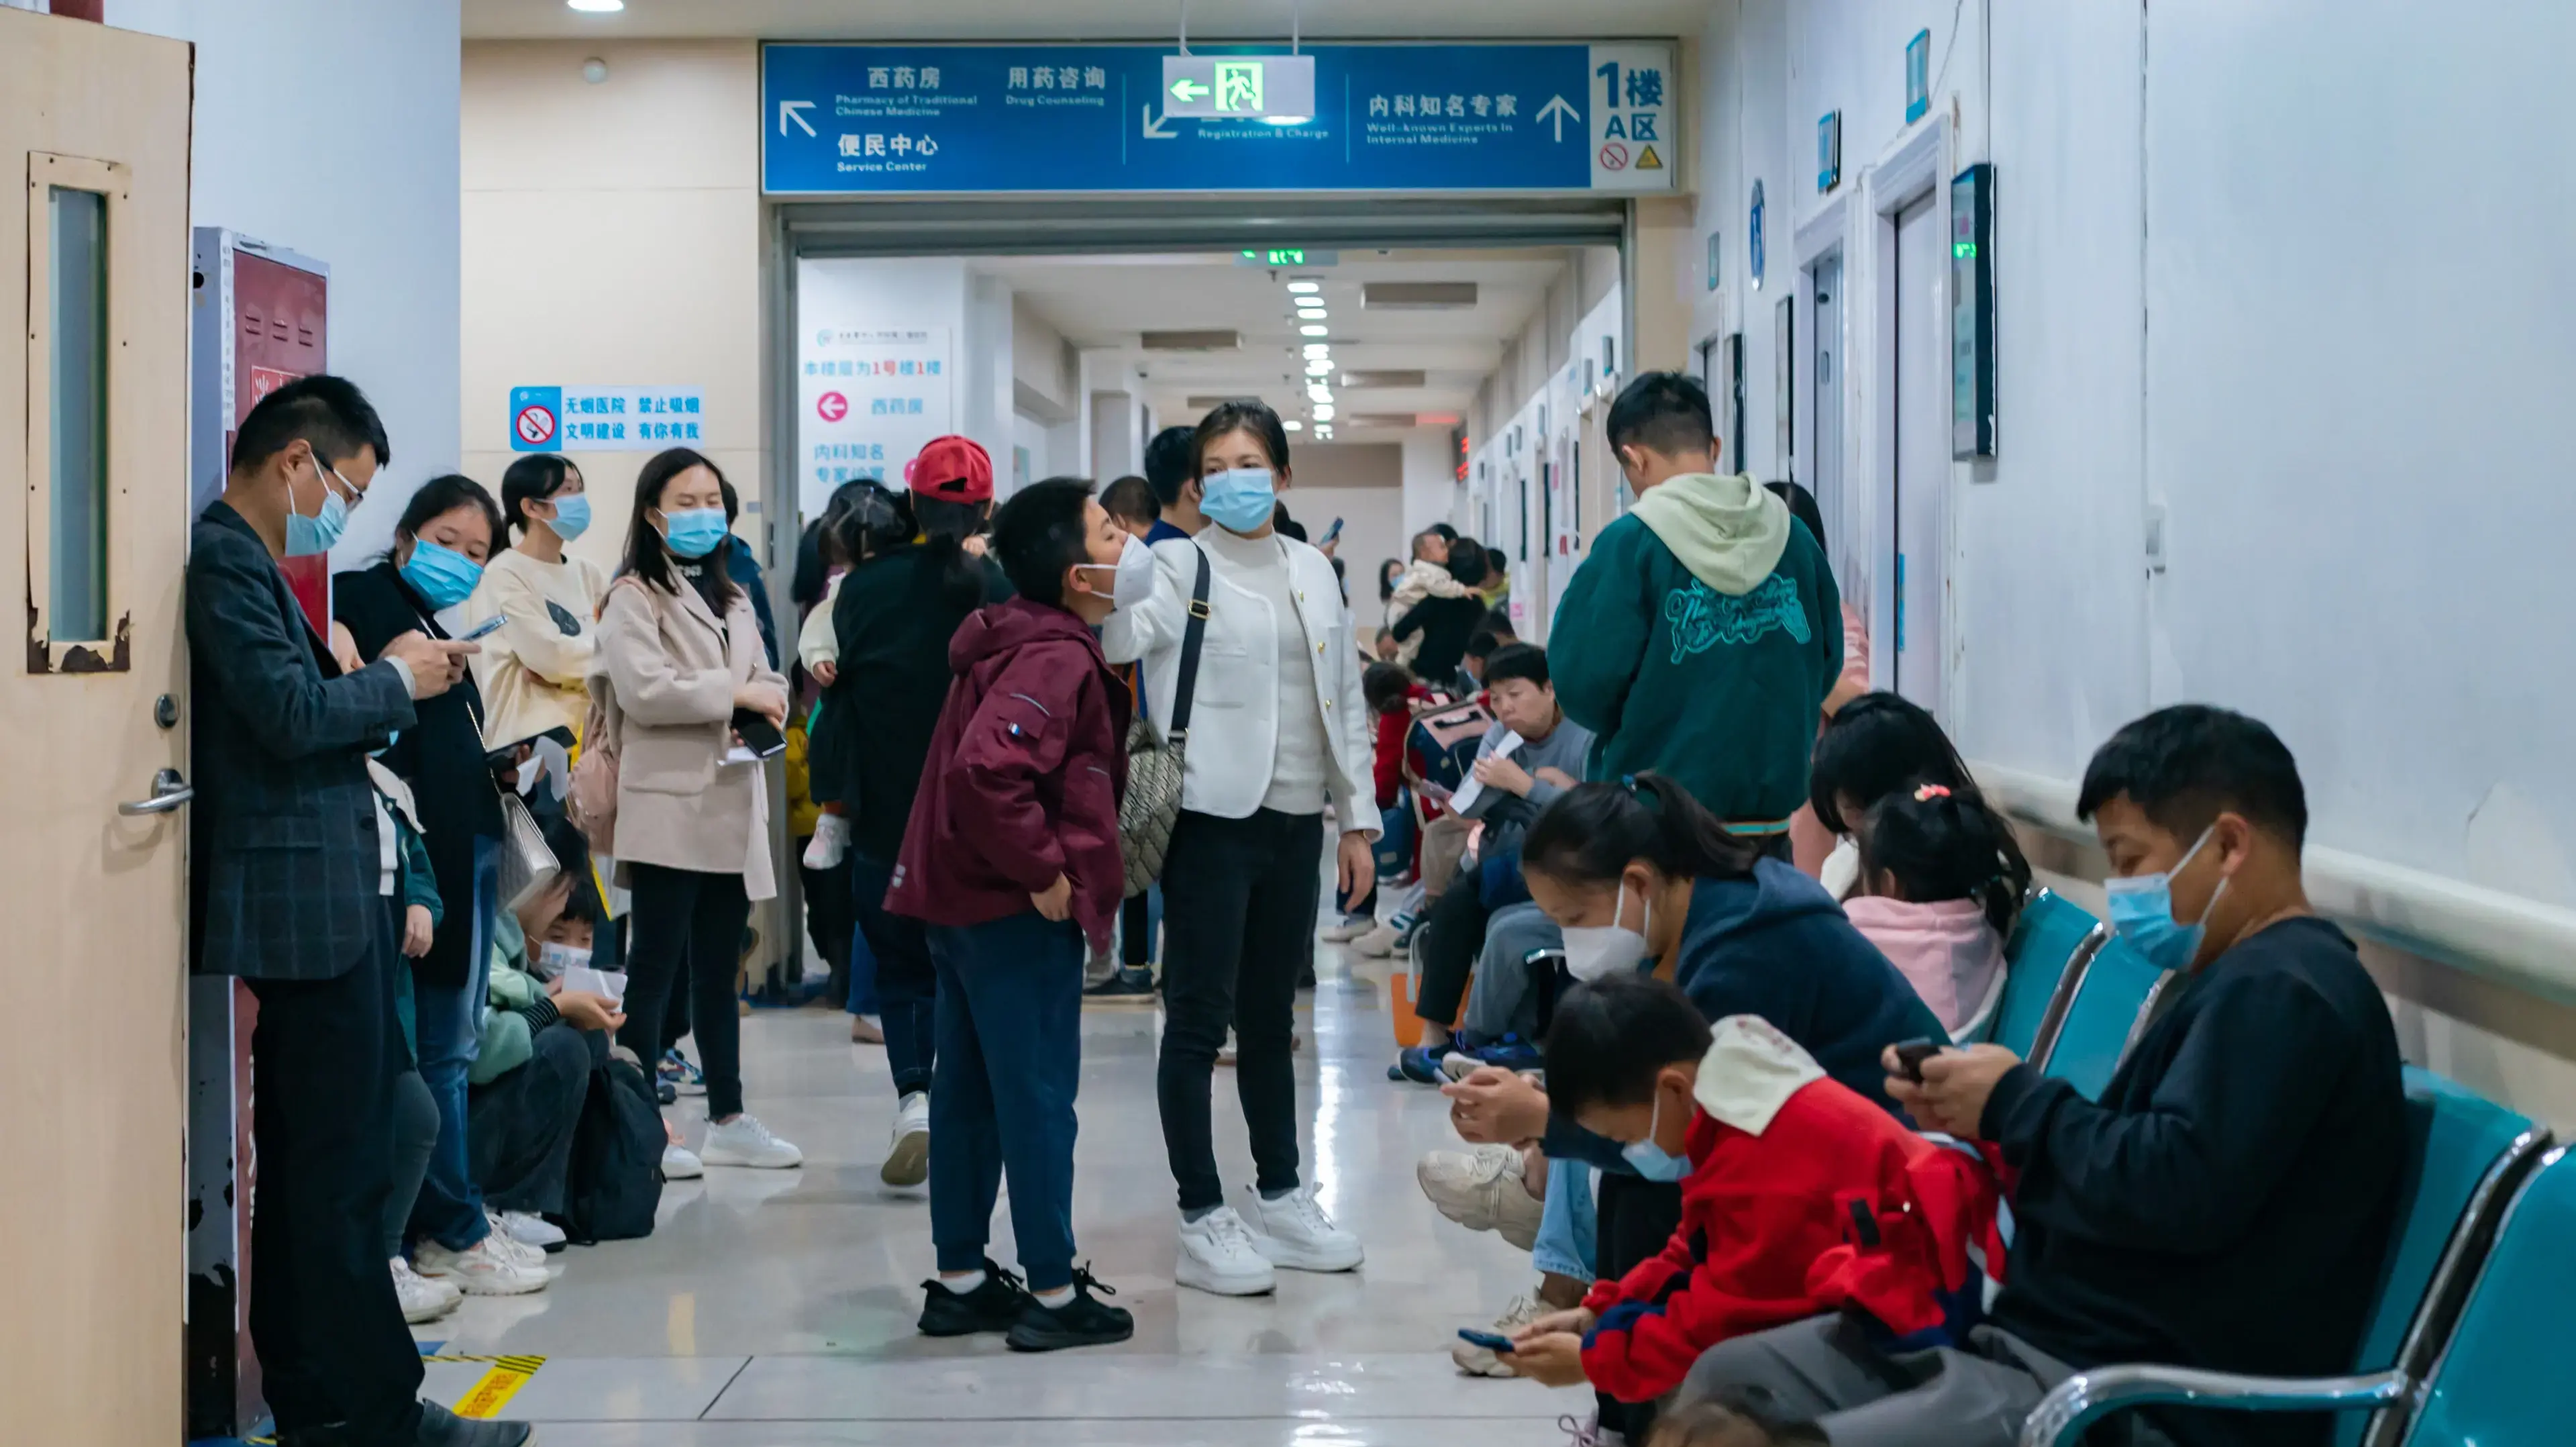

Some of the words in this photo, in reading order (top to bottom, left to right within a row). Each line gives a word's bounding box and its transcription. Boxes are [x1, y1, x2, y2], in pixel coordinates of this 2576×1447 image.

[868, 66, 940, 89] 西药房
[1008, 66, 1105, 89] 用药咨询
[1596, 61, 1663, 108] 1楼
[835, 95, 894, 105] Pharmacy
[897, 95, 909, 104] of
[913, 95, 978, 105] Traditional
[1007, 95, 1034, 107] Drug
[1370, 94, 1517, 117] 内科知名专家
[835, 107, 883, 115] Chinese
[886, 107, 940, 115] Medicine
[1198, 128, 1271, 140] Registration
[1275, 128, 1283, 138] &
[1287, 128, 1329, 140] Charge
[1449, 123, 1497, 134] Experts
[1604, 113, 1659, 141] A区
[838, 134, 938, 156] 便民中心
[1368, 134, 1416, 144] Internal
[1420, 134, 1478, 144] Medicine
[837, 161, 883, 172] Service
[886, 161, 926, 171] Center
[566, 397, 626, 414] 无烟医院
[638, 397, 700, 414] 禁止吸烟
[872, 399, 923, 415] 西药房
[566, 423, 625, 440] 文明建设
[638, 423, 699, 440] 有你有我
[814, 444, 884, 461] 内科知名
